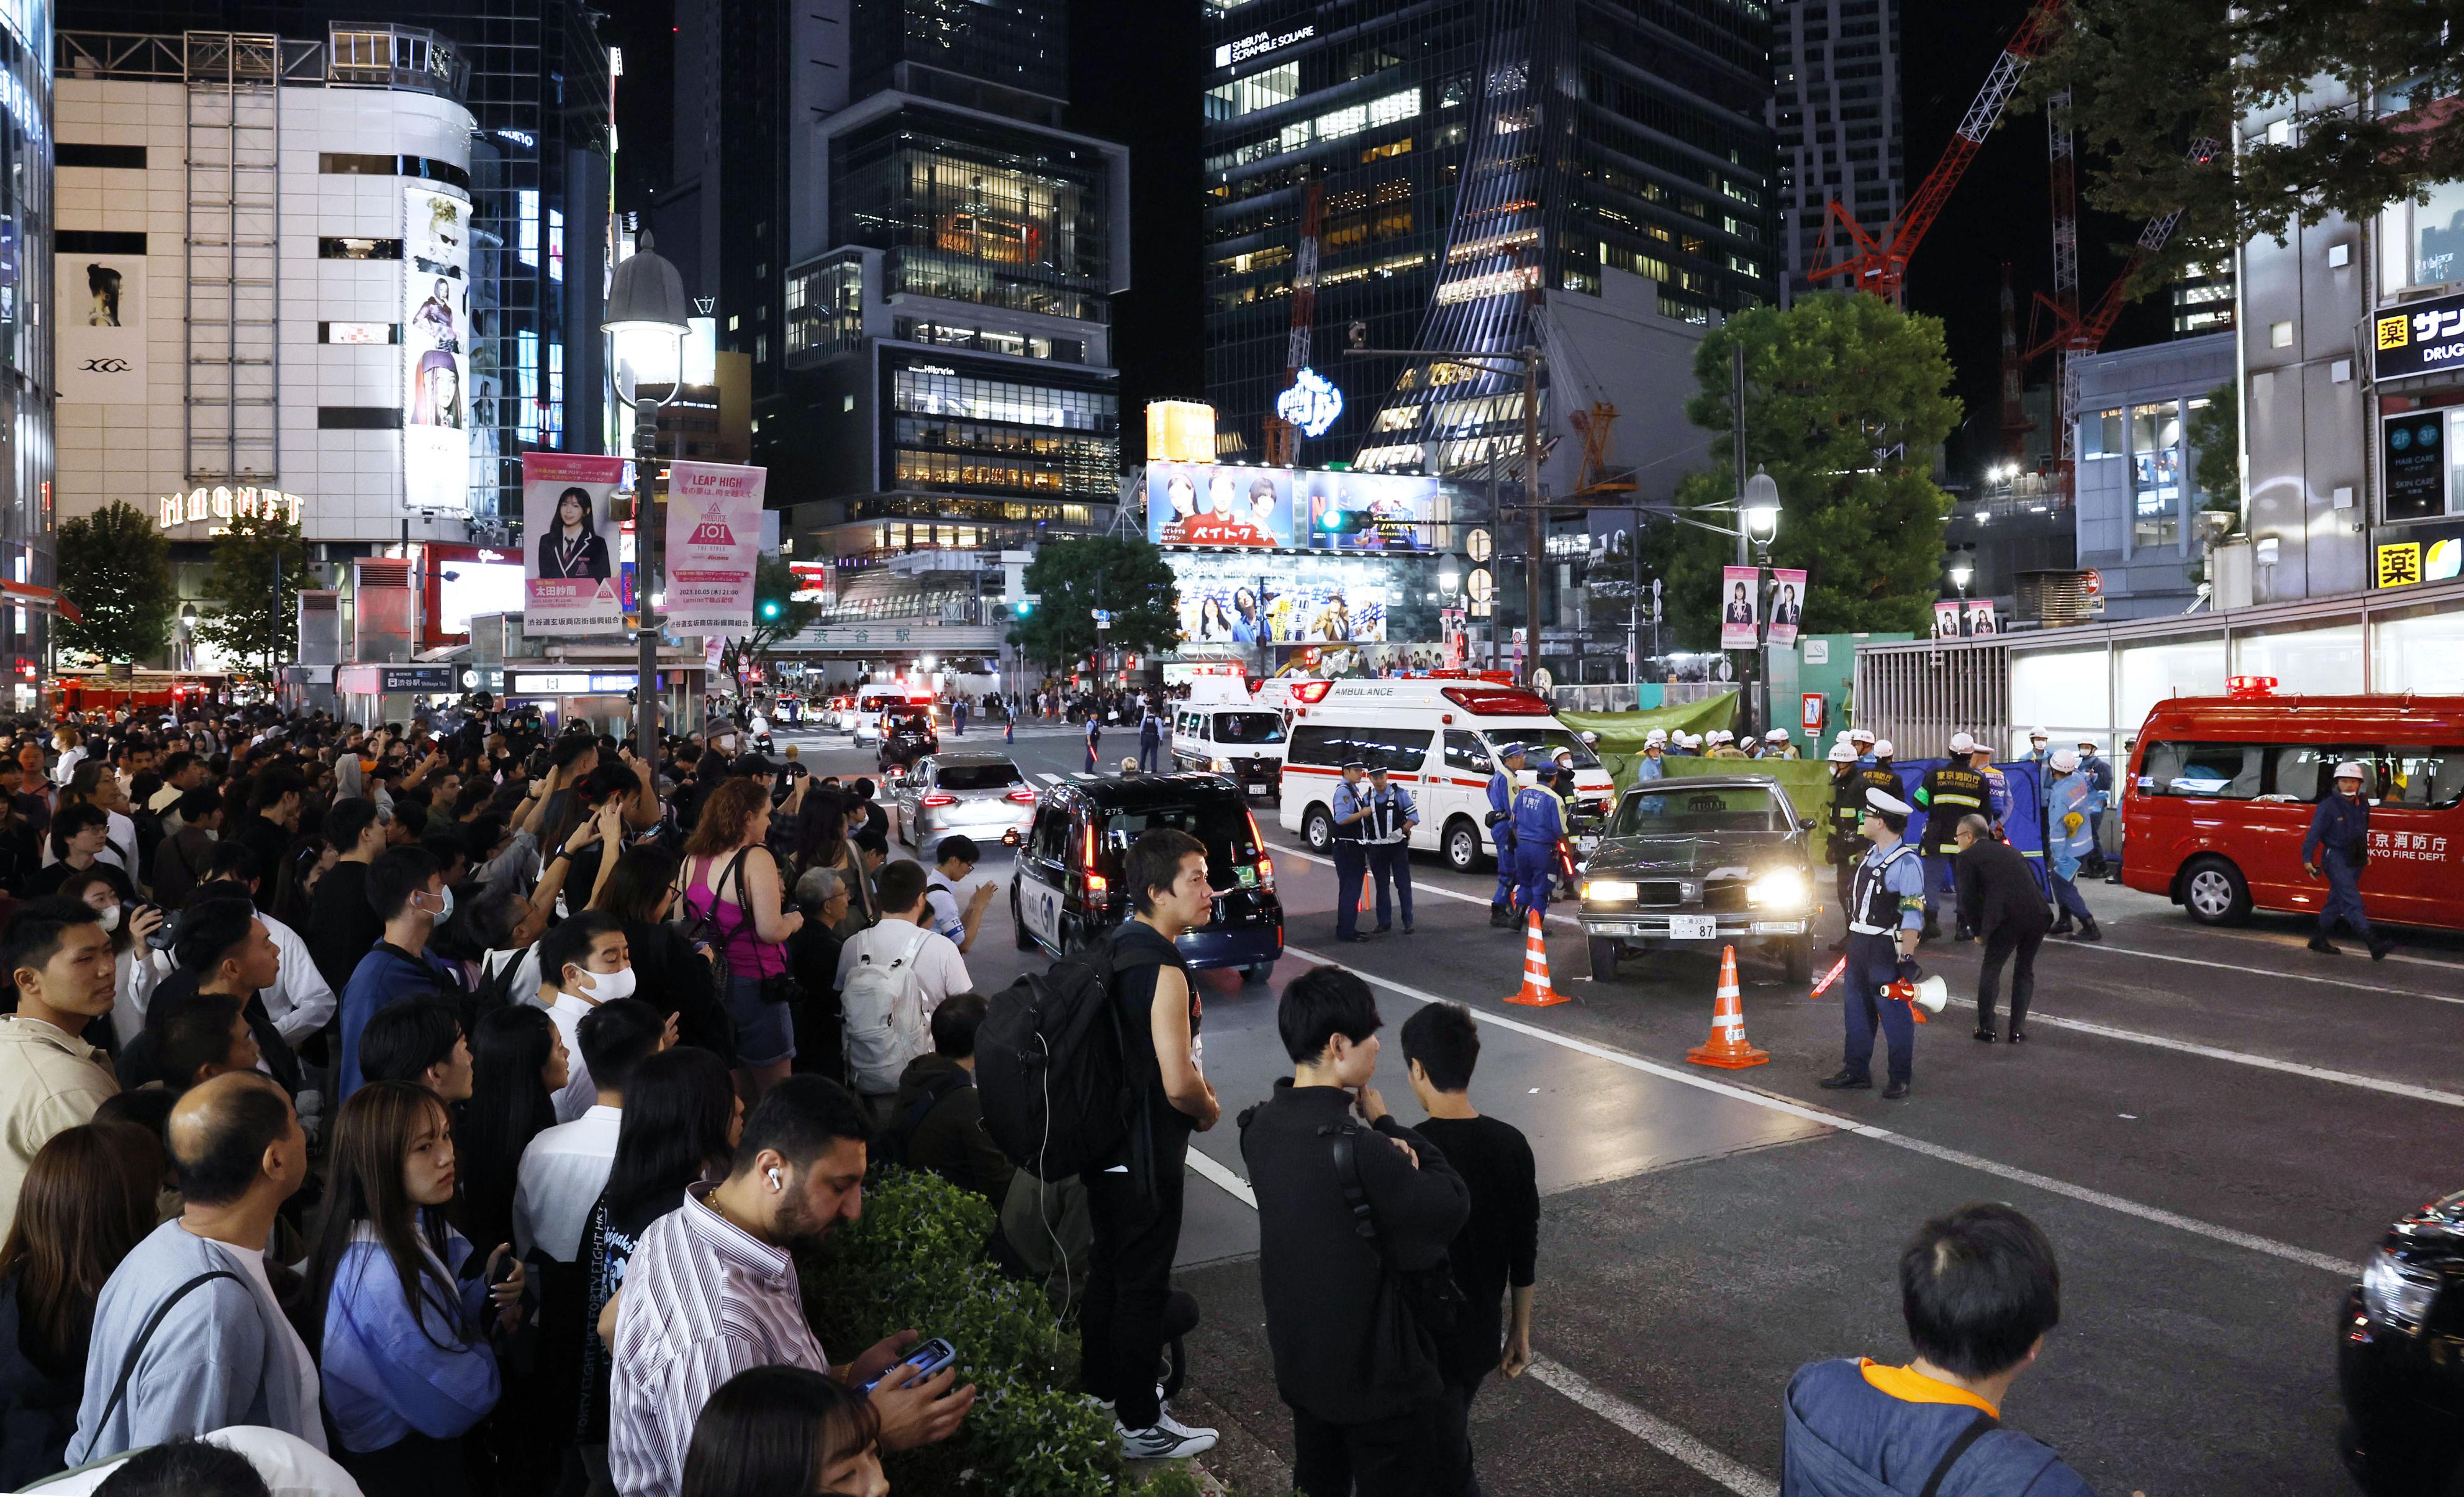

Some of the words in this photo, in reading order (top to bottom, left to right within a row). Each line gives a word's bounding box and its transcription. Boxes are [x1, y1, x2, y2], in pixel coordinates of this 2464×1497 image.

[1232, 32, 1269, 52] SHIBUYA
[1232, 38, 1277, 62] SCRAMBLE
[1278, 25, 1314, 47] SQUARE
[2381, 320, 2404, 345] 薬
[924, 365, 955, 376] Hikarie
[2393, 433, 2408, 445] 2F
[2421, 429, 2437, 442] 3F
[2396, 457, 2412, 466] HAIR
[2414, 454, 2434, 463] CARE
[692, 475, 716, 486] LEAP
[719, 476, 742, 488] HIGH
[2395, 480, 2413, 489] SKIN
[2414, 478, 2435, 486] CARE
[160, 486, 304, 528] MAGNET
[701, 514, 727, 522] PRODUCE
[700, 526, 725, 539] 101
[1192, 527, 1251, 540] ペイトク
[2383, 548, 2416, 584] 薬
[813, 628, 910, 643] 渋谷駅
[1335, 688, 1394, 696] AMBULANCE
[1182, 758, 1194, 770] POLICE
[1937, 771, 1980, 784] 東京消防庁
[1523, 796, 1540, 805] 警視庁
[2393, 850, 2416, 860] FIRE
[2418, 852, 2447, 862] DEPT.
[1700, 926, 1713, 937] 87
[591, 1232, 604, 1275] EIGHT
[586, 1277, 603, 1318] FORTY
